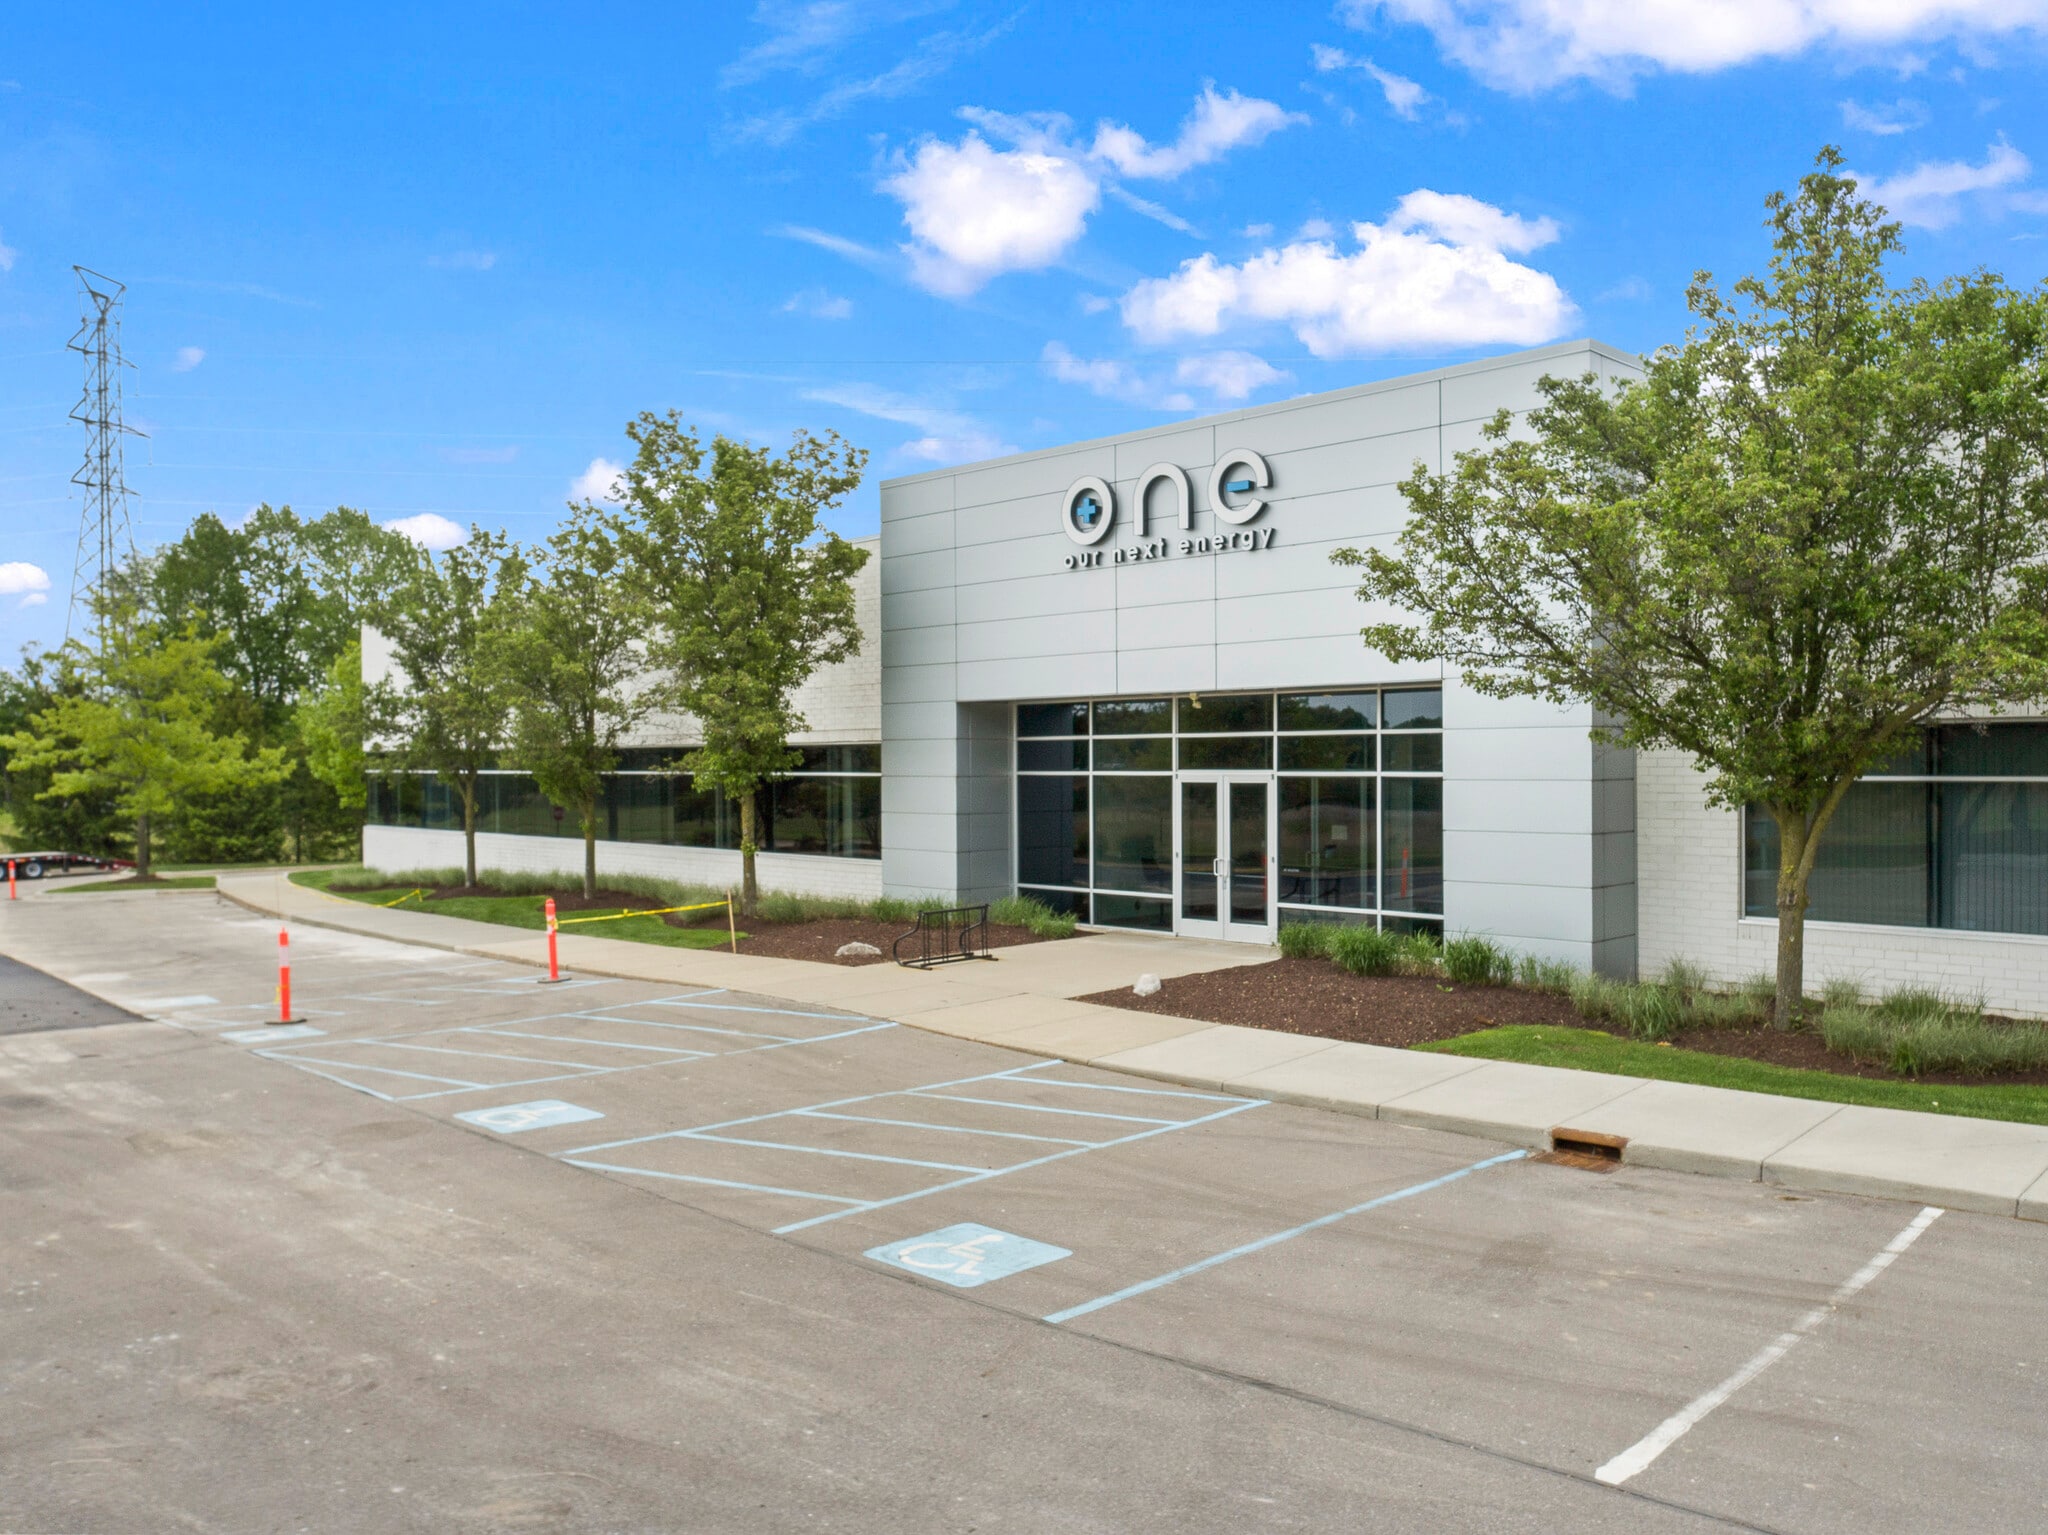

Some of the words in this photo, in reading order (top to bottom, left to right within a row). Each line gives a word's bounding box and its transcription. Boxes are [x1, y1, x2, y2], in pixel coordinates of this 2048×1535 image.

[1062, 448, 1272, 546] one
[1063, 550, 1101, 569] our
[1112, 537, 1166, 563] next
[1178, 527, 1274, 551] energy
